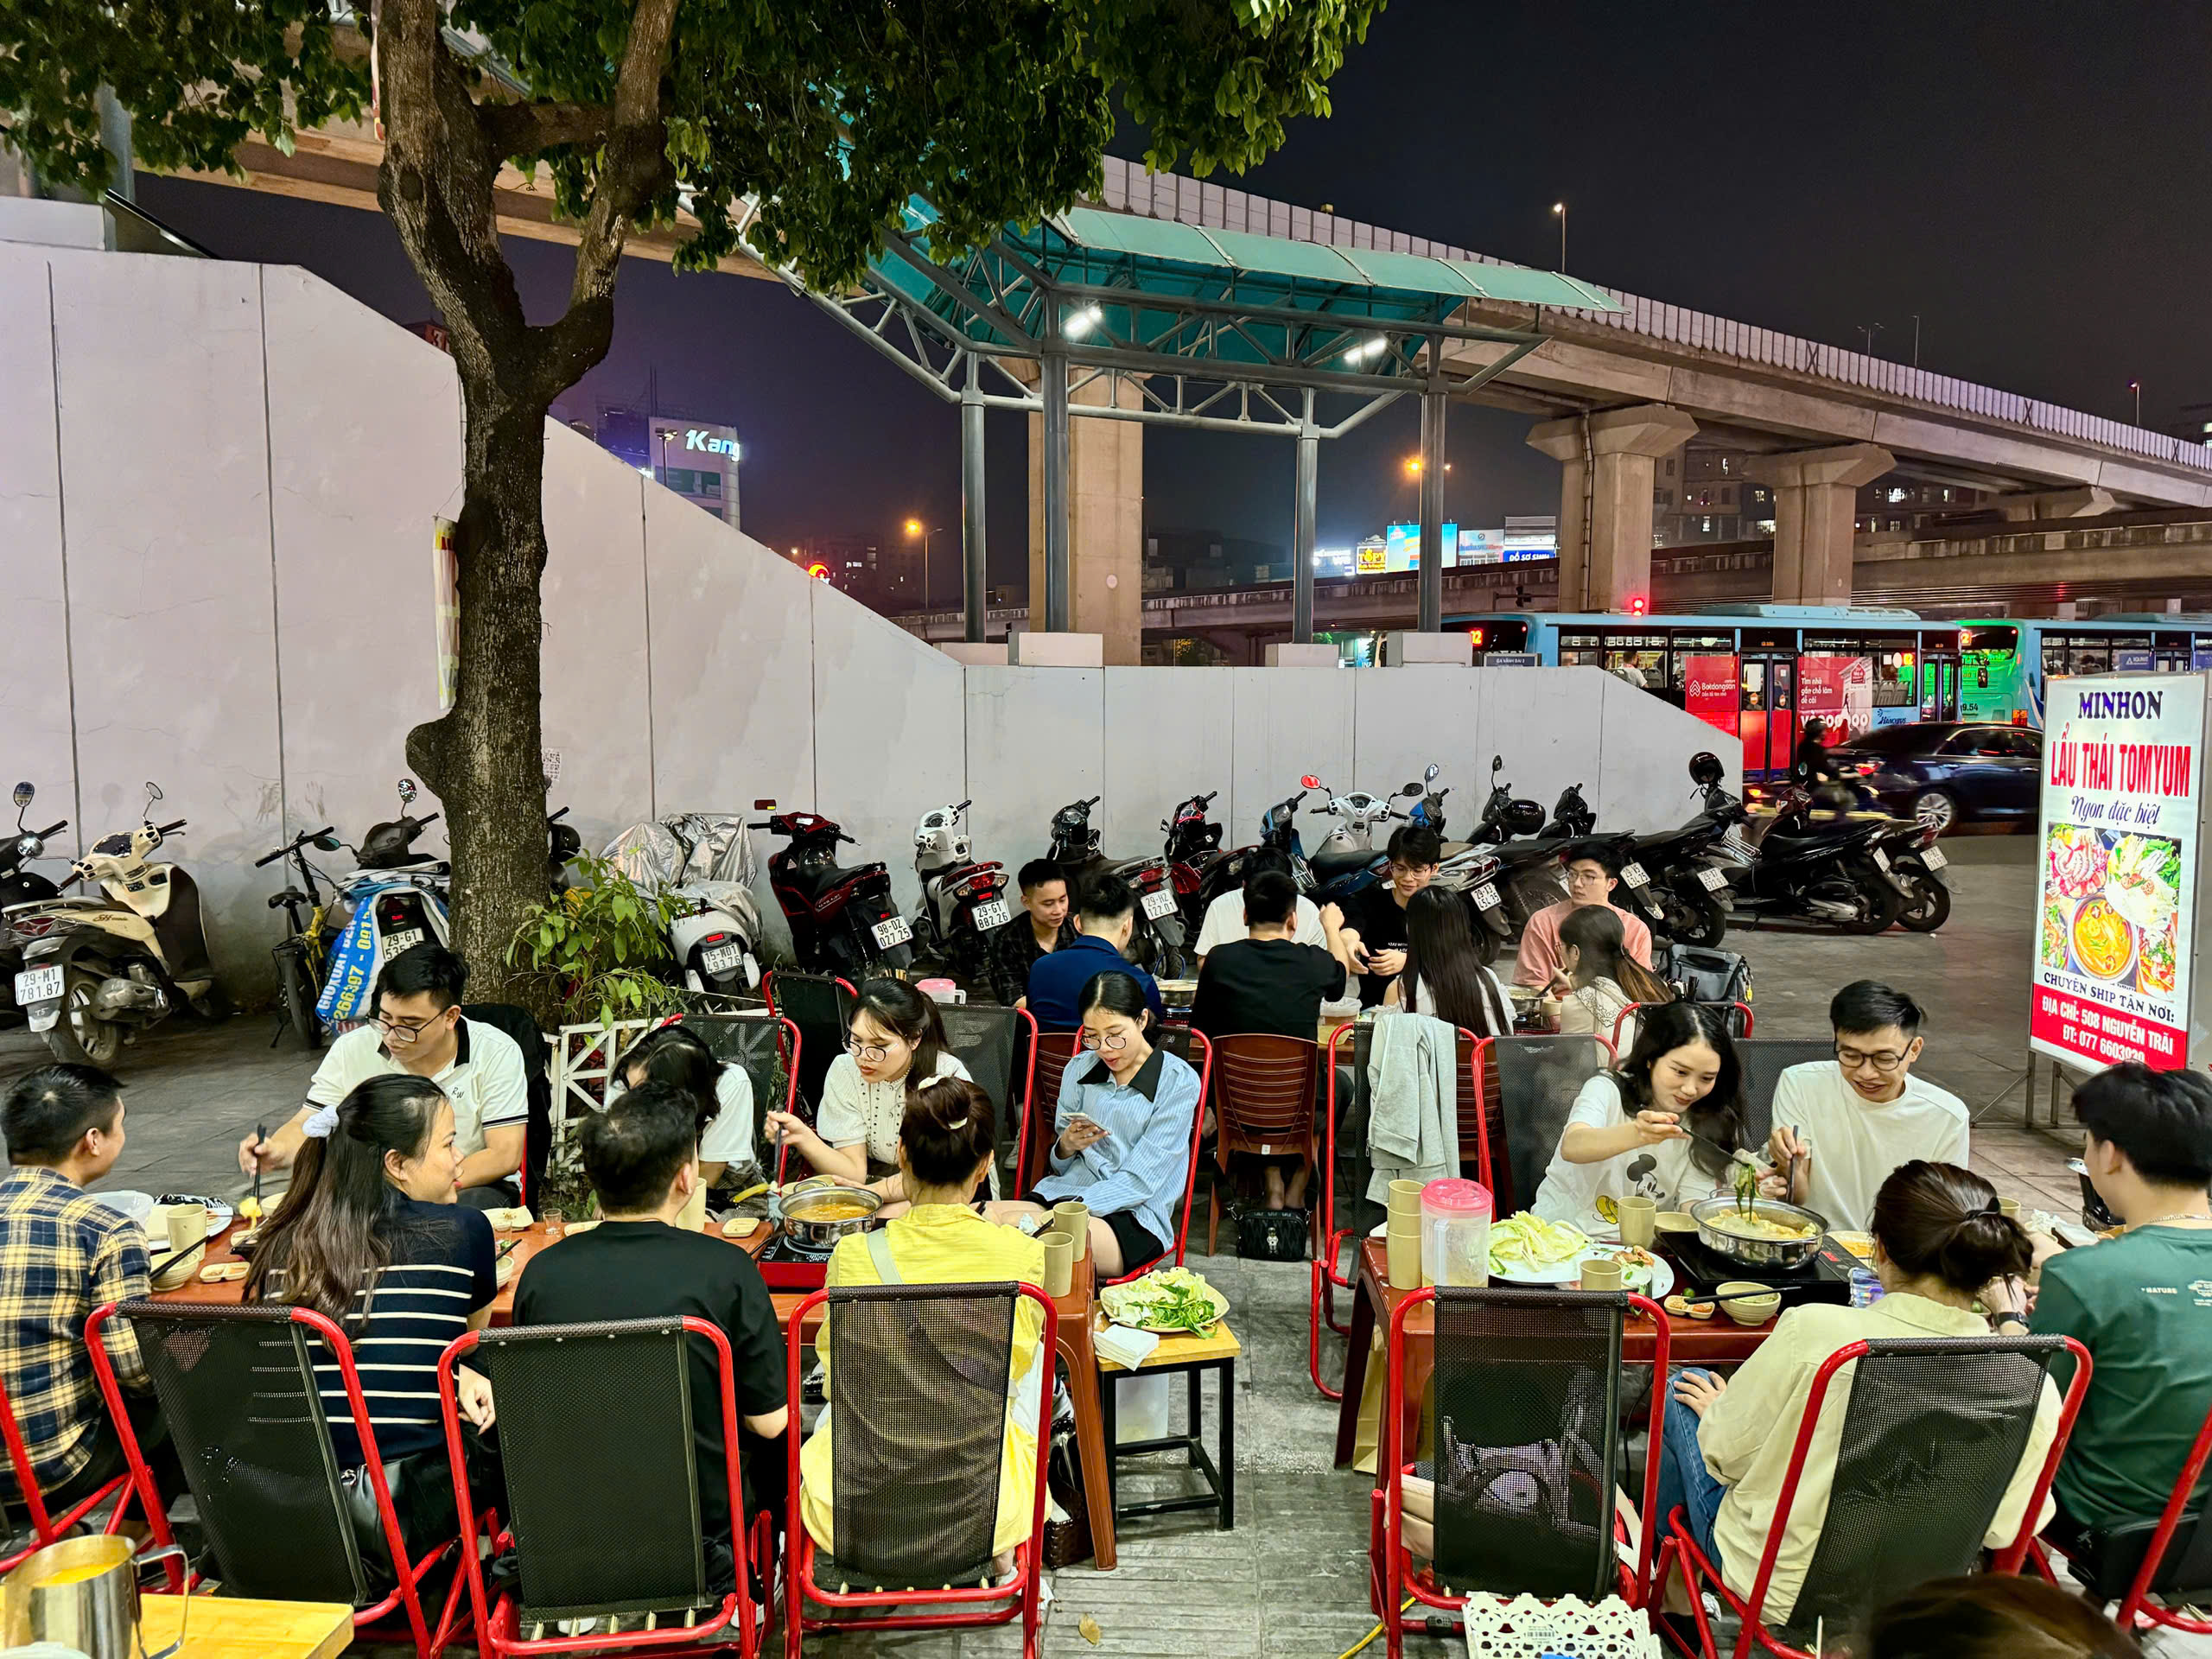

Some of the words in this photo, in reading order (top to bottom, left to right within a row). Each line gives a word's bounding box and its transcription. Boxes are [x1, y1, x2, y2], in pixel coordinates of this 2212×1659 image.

[2078, 691, 2163, 719] MINHON
[2050, 721, 2077, 787] LẨU
[2082, 733, 2113, 791] THÁI
[2120, 744, 2191, 797] TOMYUM
[2071, 795, 2104, 823] Ngon
[2108, 800, 2132, 825] đặc
[2134, 802, 2161, 830] biệt
[977, 903, 1001, 917] 29-G1
[386, 931, 416, 947] 29-G1
[877, 918, 903, 936] 98-D2
[23, 969, 55, 986] 29-M1
[21, 982, 60, 1002] 781.87
[2044, 972, 2088, 995] CHUYÊN
[2090, 986, 2116, 1005] SHIP
[2120, 995, 2145, 1014] TẬN
[2042, 995, 2058, 1016] ĐỊA
[2060, 1000, 2079, 1022] CHỈ:
[2081, 1009, 2100, 1029] 508
[2101, 1015, 2145, 1046] NGUYỄN
[2063, 1024, 2077, 1043] ĐT:
[2079, 1029, 2098, 1050] 077
